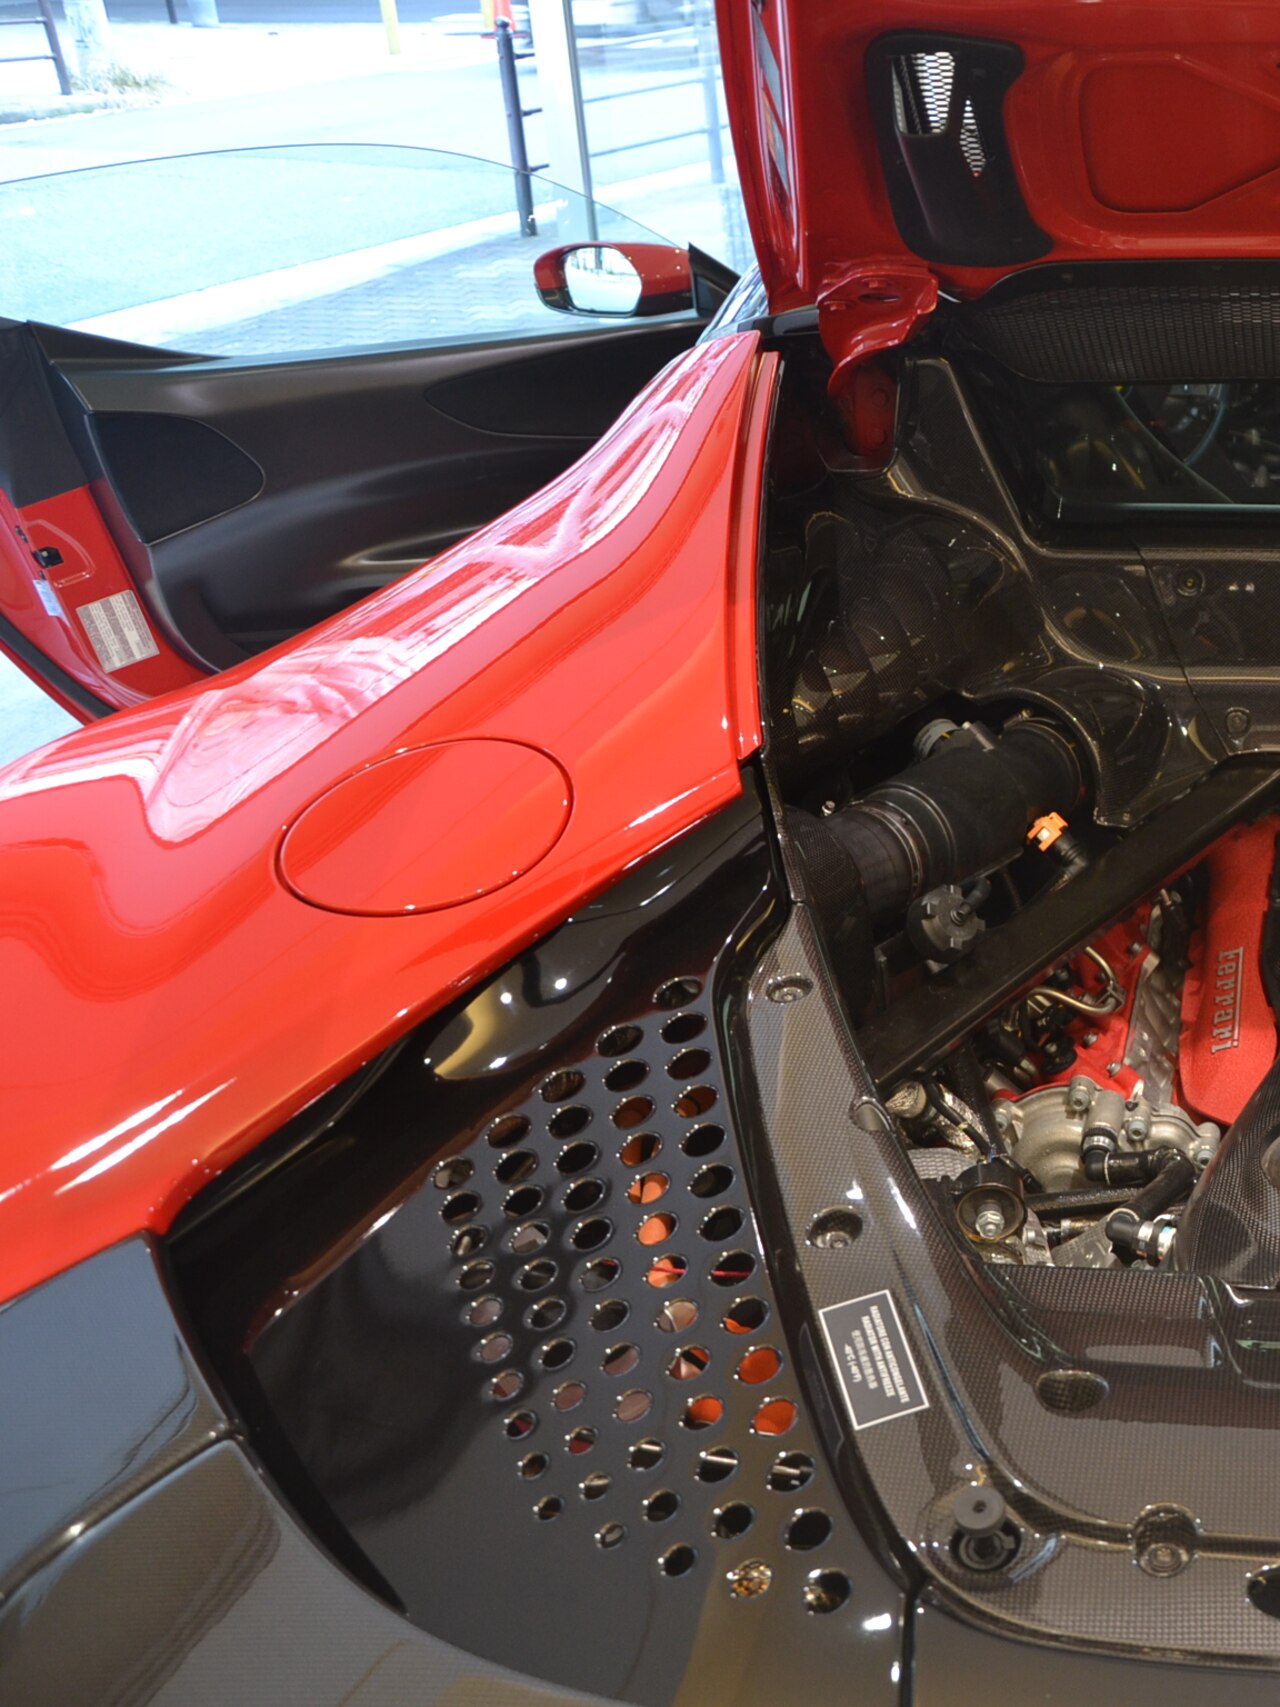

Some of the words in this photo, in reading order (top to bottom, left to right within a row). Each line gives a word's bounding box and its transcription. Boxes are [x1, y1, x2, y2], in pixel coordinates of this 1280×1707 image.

[1211, 946, 1244, 1054] Ferrari
[861, 1315, 878, 1346] RADIATOR
[871, 1344, 883, 1361] WITH
[870, 1305, 887, 1337] RADIATORE
[880, 1337, 891, 1350] CON
